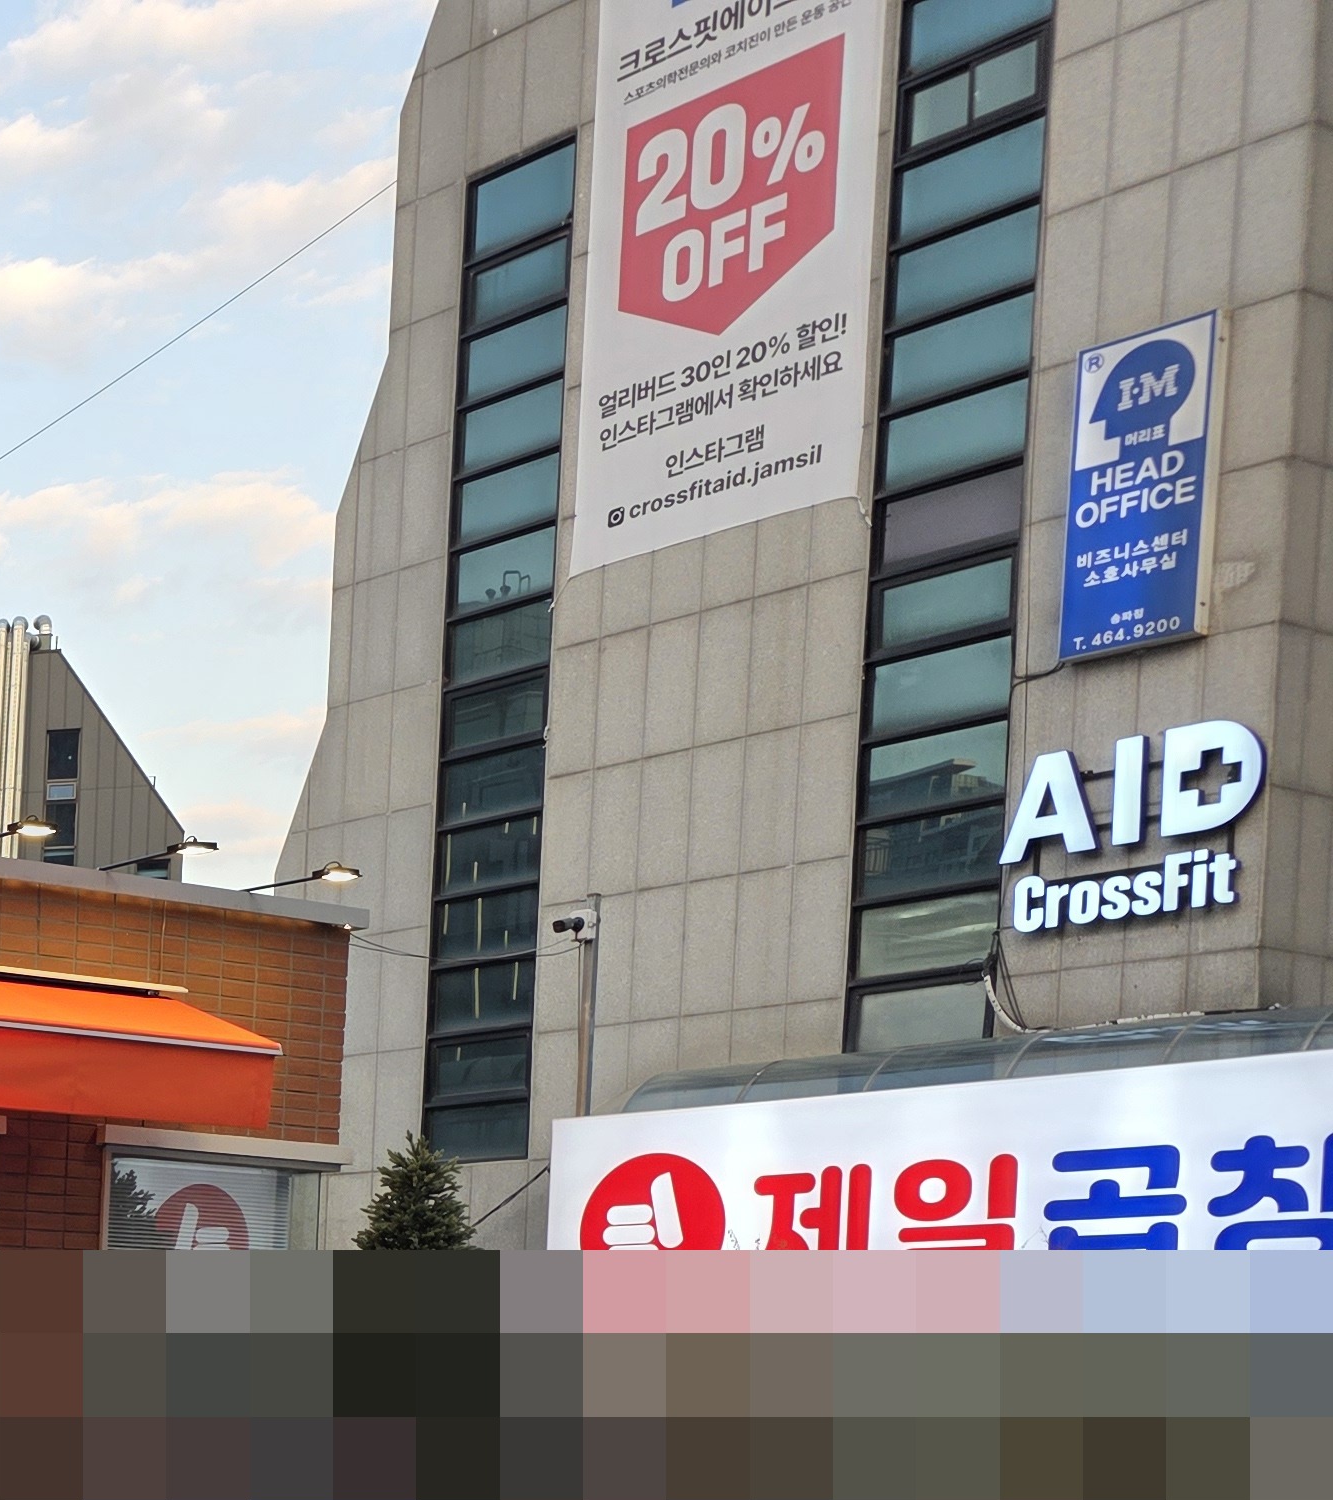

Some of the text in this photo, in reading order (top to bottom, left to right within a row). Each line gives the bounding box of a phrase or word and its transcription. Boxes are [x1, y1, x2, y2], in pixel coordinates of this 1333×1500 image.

[617, 0, 799, 82] 크로스핏에이
[724, 28, 771, 59] 코치진이
[773, 16, 798, 37] 만든
[800, 4, 825, 26] 운동
[636, 102, 825, 237] 20%
[662, 192, 787, 302] OFF
[598, 313, 847, 419] 얼리버드 30인 20% 할인!
[600, 351, 843, 451] 인스타그램에서 확인하세요
[629, 444, 822, 518] crossfitaid.jamsil
[666, 424, 765, 478] 인스타그램
[1091, 450, 1185, 496] HEAD
[1076, 476, 1196, 528] OFFICE
[1076, 529, 1188, 568] 비즈니스센터
[1083, 551, 1177, 587] 소호사무실
[1073, 616, 1180, 650] T. 464.9200
[999, 719, 1267, 864] AID
[1013, 848, 1240, 933] CrossFit
